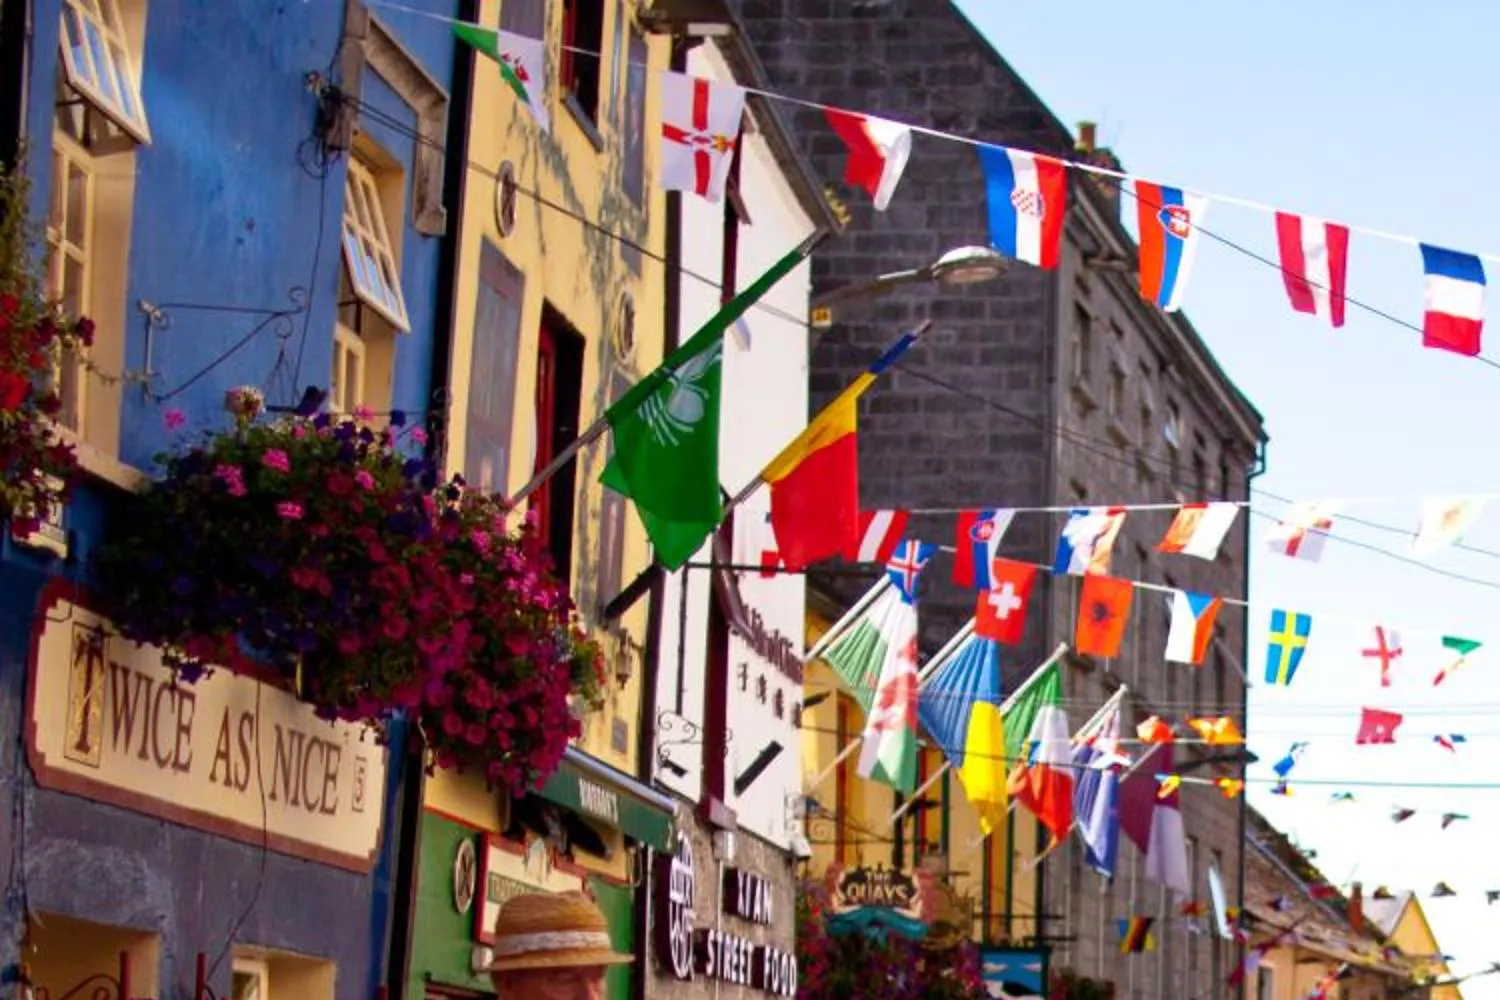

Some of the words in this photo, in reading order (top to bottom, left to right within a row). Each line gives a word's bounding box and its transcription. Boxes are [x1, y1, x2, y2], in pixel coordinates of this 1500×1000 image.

[73, 630, 196, 773] TWICE
[209, 706, 254, 791] AS
[269, 724, 341, 815] NICE
[846, 882, 909, 903] QUAYS
[705, 928, 754, 985] STREET
[764, 945, 798, 997] FOOD
